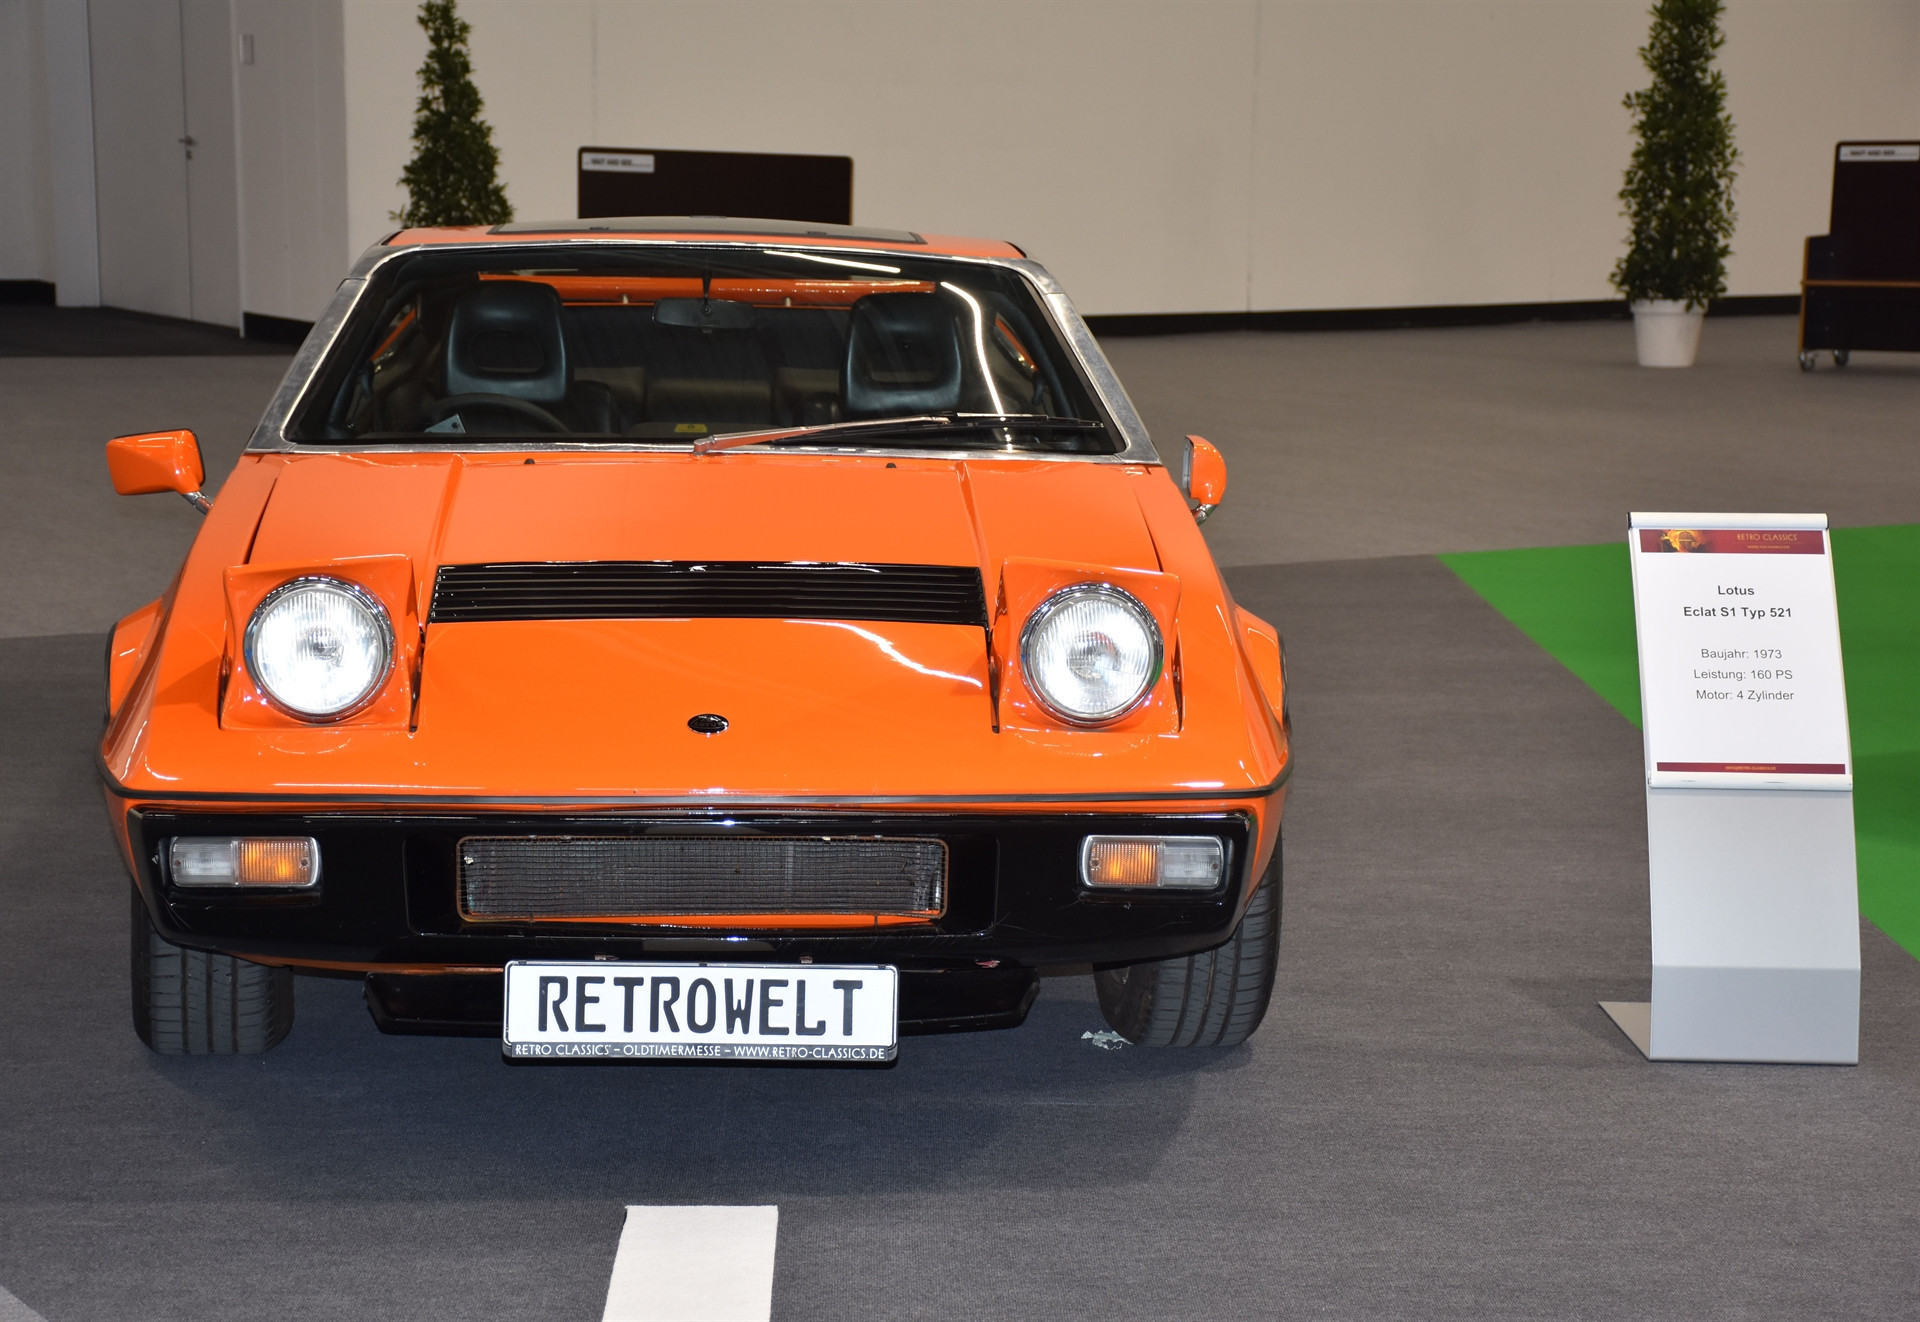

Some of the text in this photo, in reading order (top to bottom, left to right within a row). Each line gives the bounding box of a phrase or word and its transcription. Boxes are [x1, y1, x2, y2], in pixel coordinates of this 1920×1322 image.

[1736, 533, 1798, 542] RETRO CLASSICS
[1717, 585, 1755, 596] Lotus
[1683, 606, 1792, 619] Eclat S1 Typ 521
[1701, 648, 1783, 660] Baujahr: 1973
[1693, 669, 1793, 681] Leistung: 160 PS
[1696, 690, 1795, 702] Motor: 4 Zylinder
[538, 975, 864, 1036] RETROWELT
[515, 1044, 552, 1055] RETRO
[623, 1045, 721, 1057] OLDTIMERMESSE
[734, 1046, 885, 1059] WWW.RETRO-CLASSICS.DE
